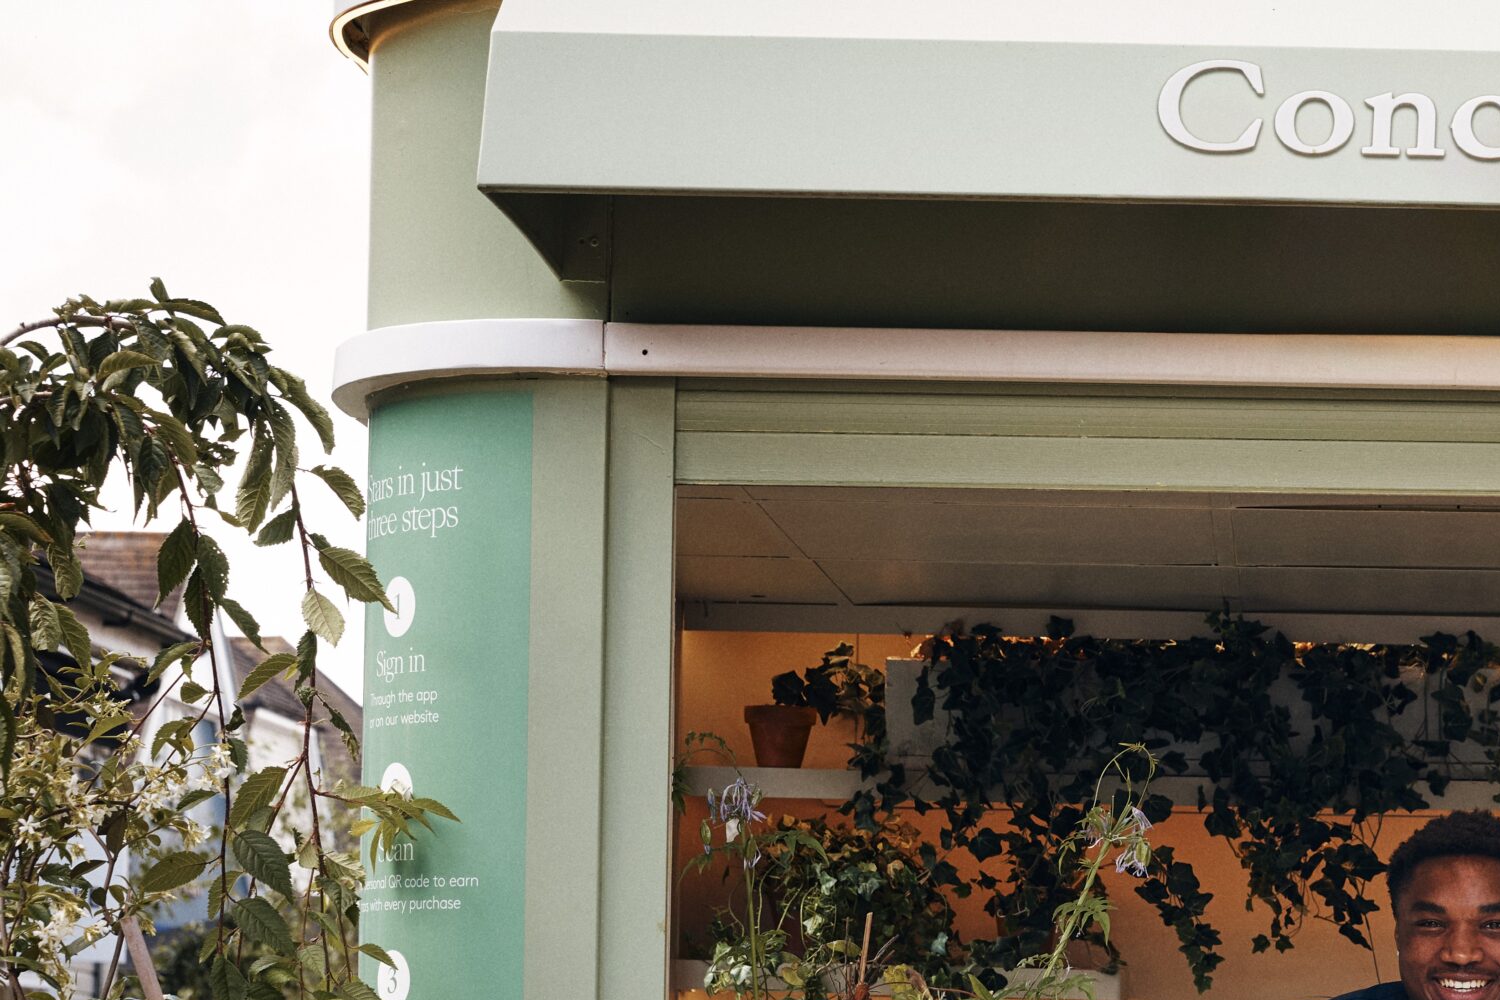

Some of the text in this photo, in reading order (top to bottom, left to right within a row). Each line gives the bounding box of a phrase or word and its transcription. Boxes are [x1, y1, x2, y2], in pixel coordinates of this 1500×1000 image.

[398, 465, 415, 496] in
[420, 462, 464, 502] just
[402, 506, 459, 538] steps
[376, 647, 426, 683] Sign in
[398, 689, 414, 703] the
[416, 690, 438, 704] app
[400, 709, 440, 725] website
[389, 874, 403, 889] QR
[404, 874, 430, 888] code
[433, 874, 446, 888] to
[449, 876, 479, 888] earn
[385, 899, 406, 915] every
[409, 896, 462, 914] purchase
[387, 966, 397, 994] 3
